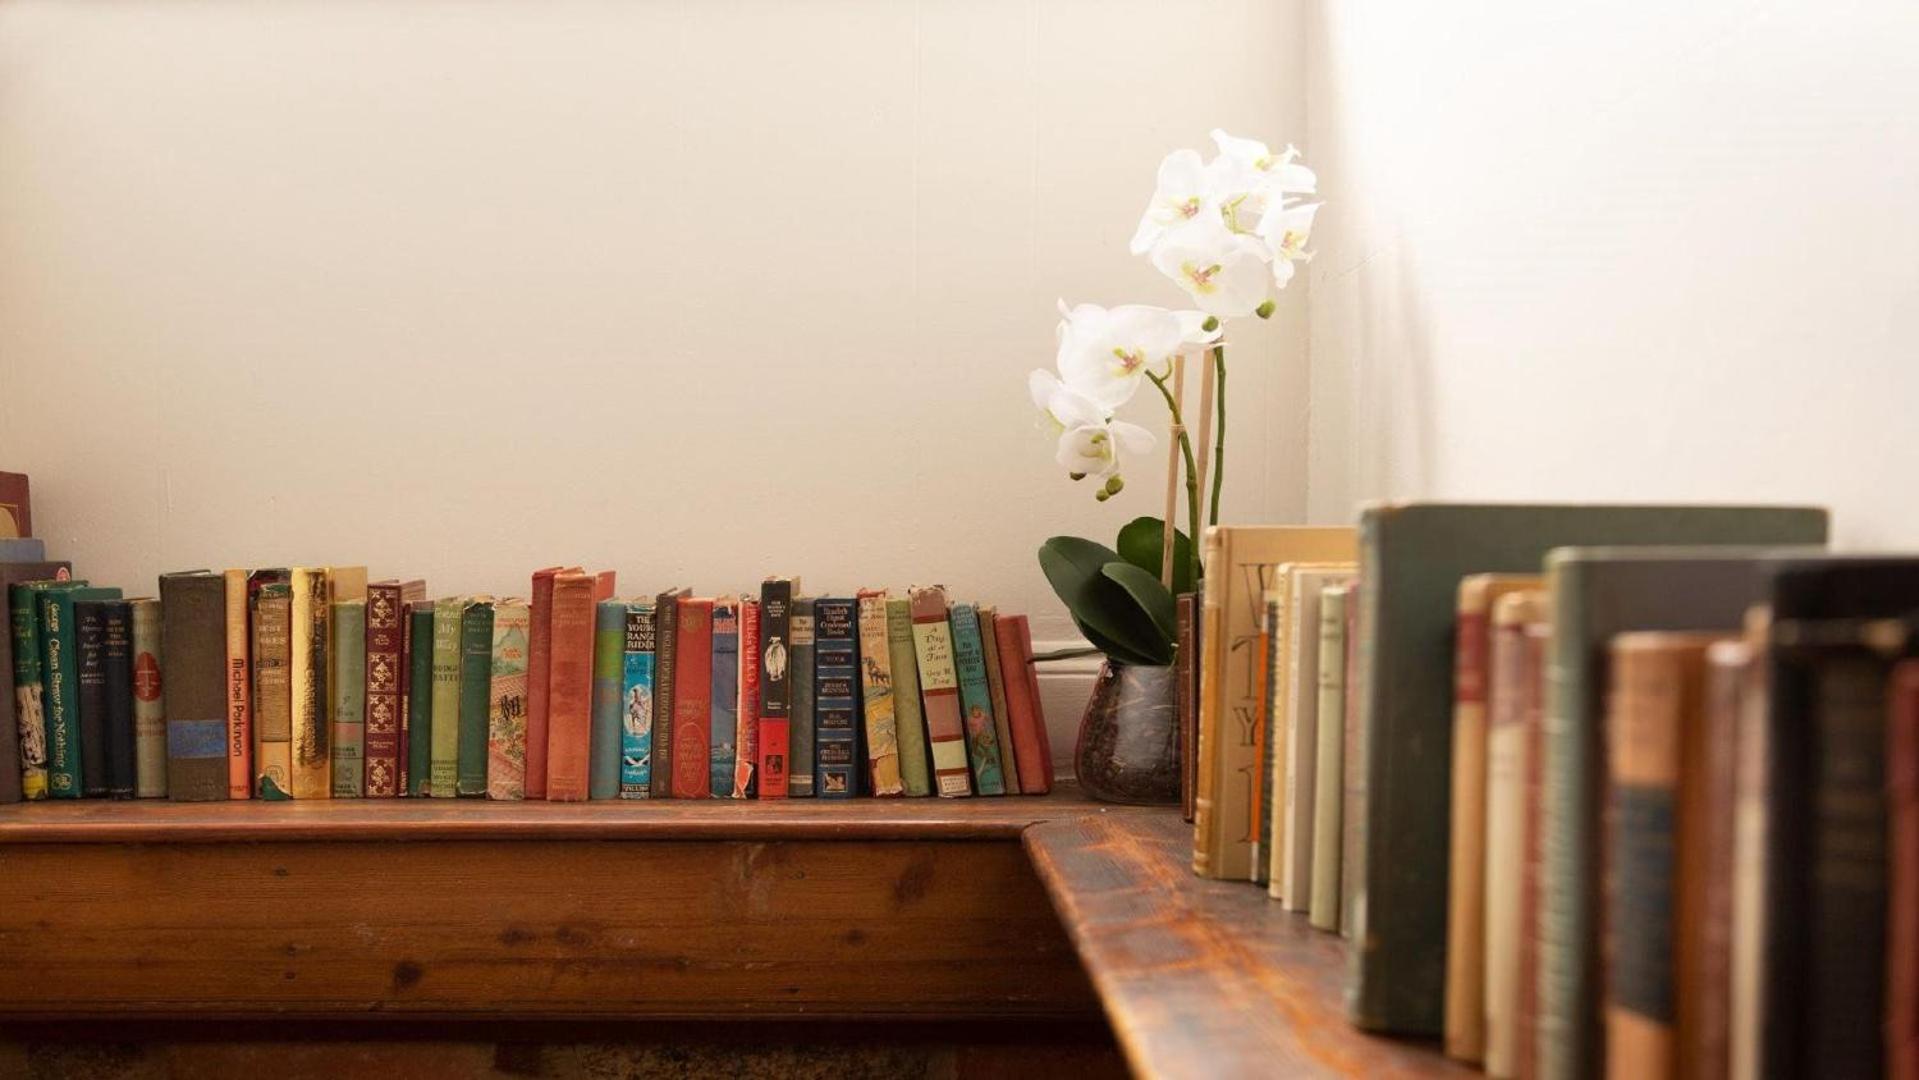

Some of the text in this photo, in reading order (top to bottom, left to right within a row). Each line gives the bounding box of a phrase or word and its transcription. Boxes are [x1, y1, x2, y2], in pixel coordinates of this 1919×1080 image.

[637, 615, 650, 623] THE
[51, 672, 63, 705] Straw
[232, 658, 245, 757] Michael Parkinson
[54, 722, 66, 768] Nothing
